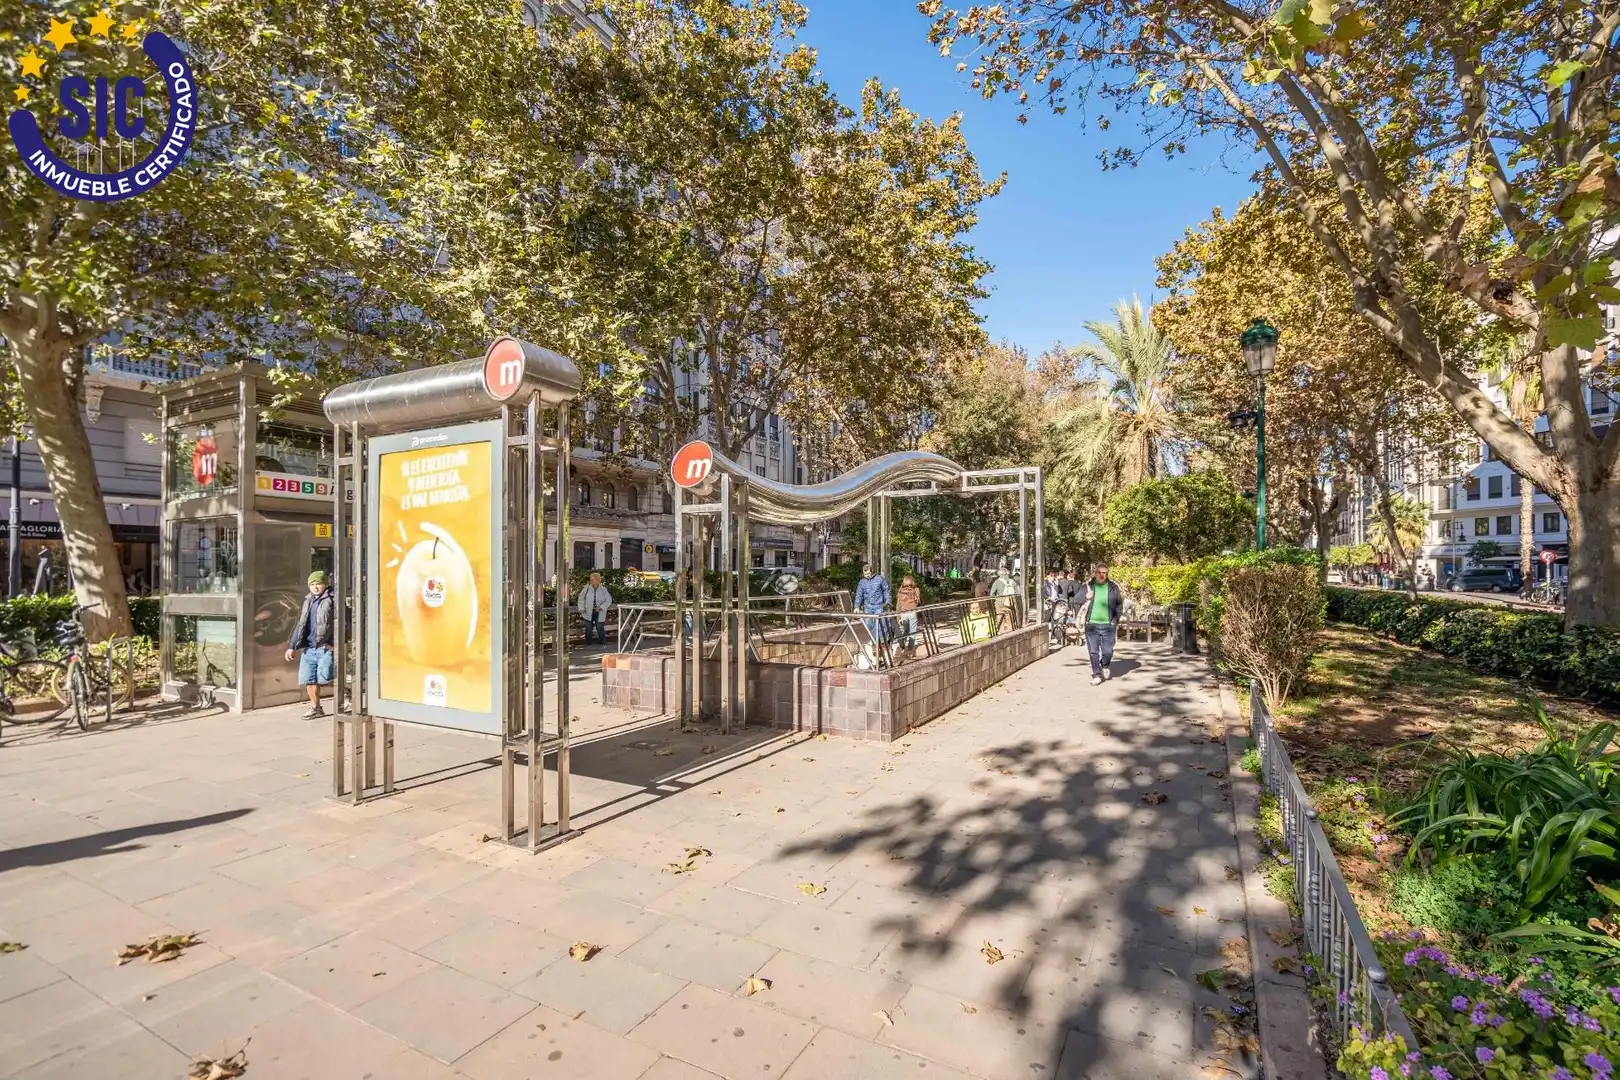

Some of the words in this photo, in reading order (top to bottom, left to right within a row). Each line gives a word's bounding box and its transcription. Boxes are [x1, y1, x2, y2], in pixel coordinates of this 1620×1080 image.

[499, 360, 522, 386] m
[201, 453, 218, 475] m
[686, 458, 711, 479] m
